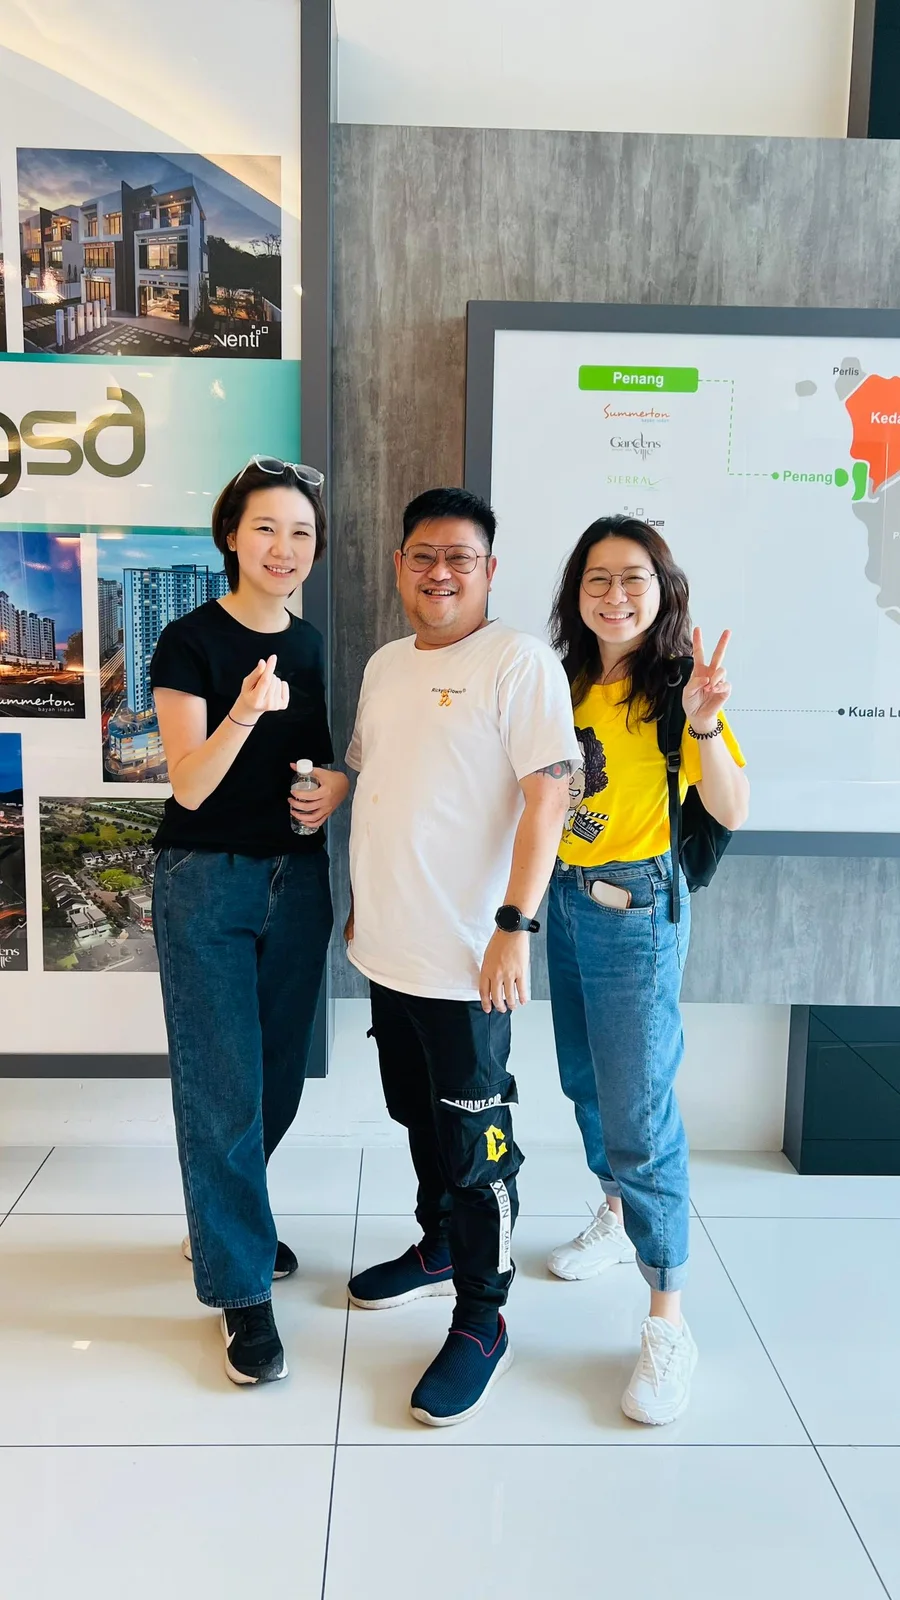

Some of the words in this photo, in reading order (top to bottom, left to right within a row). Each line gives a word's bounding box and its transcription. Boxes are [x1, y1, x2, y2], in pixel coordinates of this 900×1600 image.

[213, 330, 261, 348] venti
[832, 366, 860, 376] Perlis
[612, 371, 664, 388] Penang
[603, 403, 671, 419] Summerton
[783, 470, 833, 485] Penang
[848, 706, 886, 718] Kuala
[889, 706, 900, 718] L
